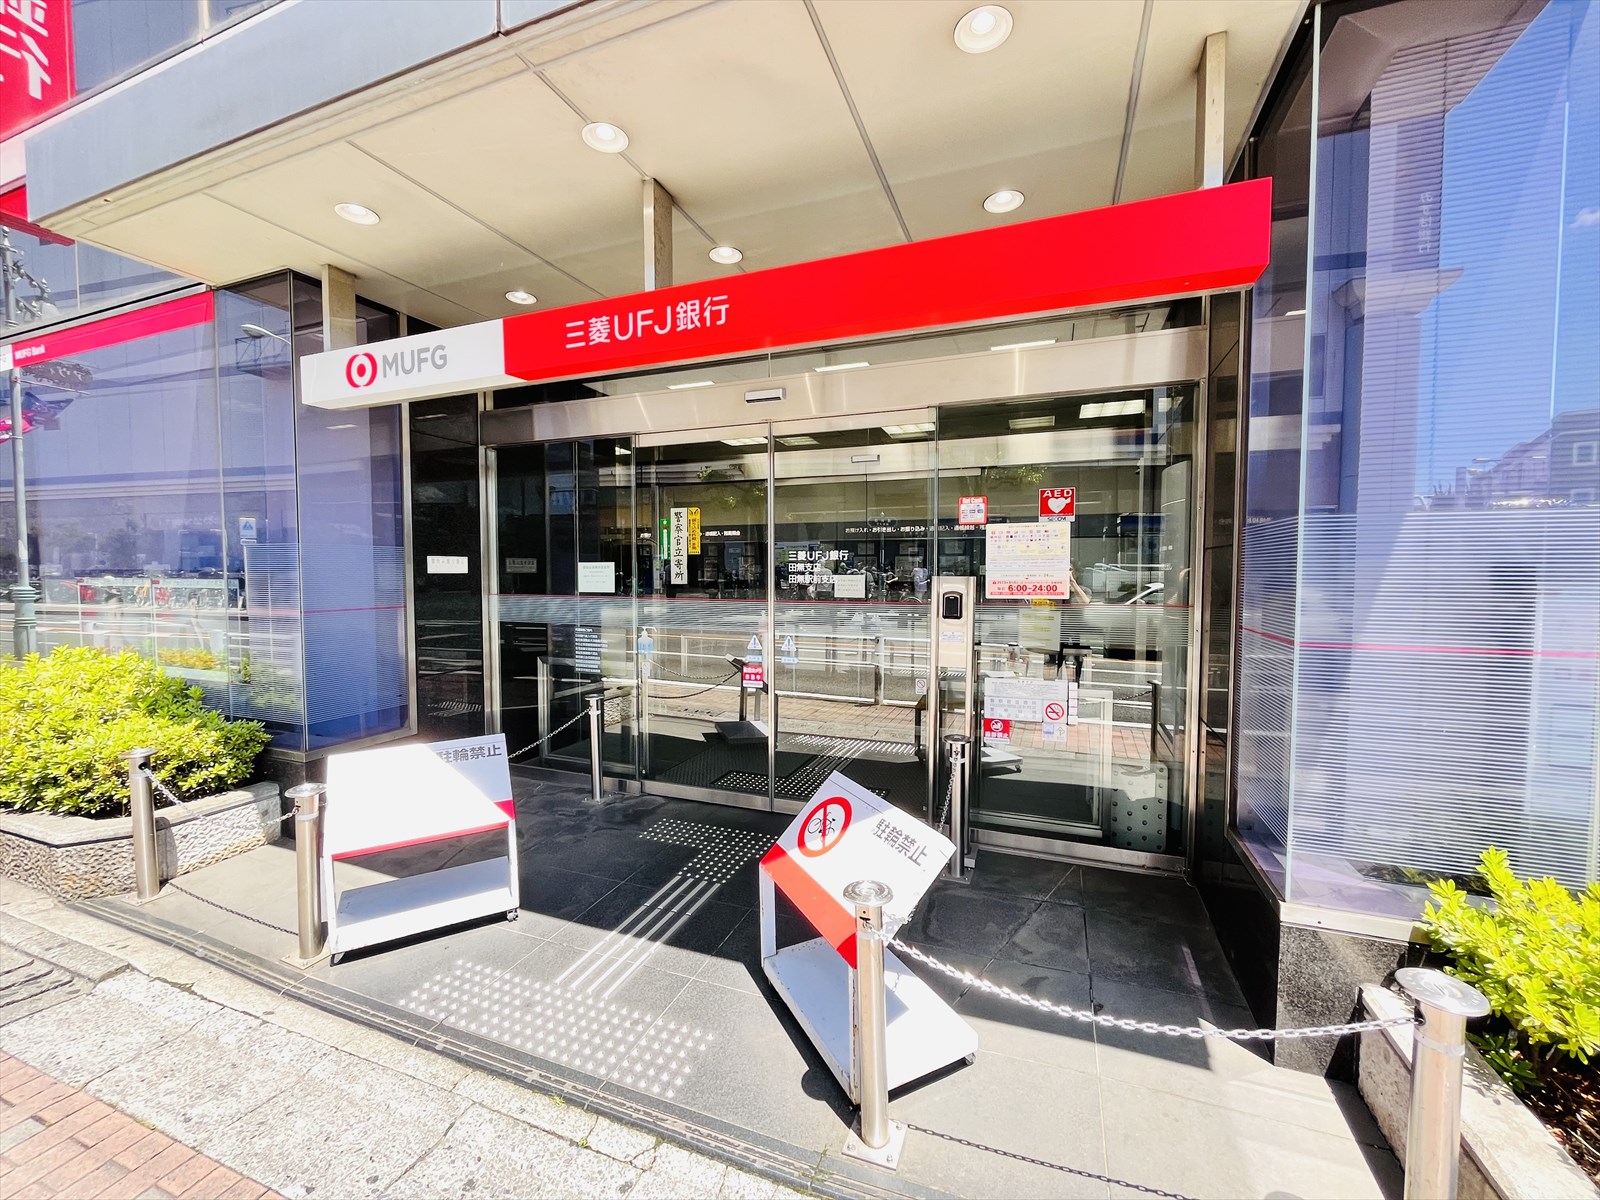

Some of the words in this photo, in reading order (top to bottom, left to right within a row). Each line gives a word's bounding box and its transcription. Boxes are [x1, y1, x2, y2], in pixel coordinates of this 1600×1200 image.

[565, 294, 730, 349] 三菱UFJ銀行
[382, 344, 448, 378] MUFG
[1042, 489, 1072, 498] AED
[673, 511, 684, 582] 警察官立寄所
[788, 550, 849, 561] 三菱UFJ銀行
[872, 818, 928, 867] 駐輪禁止
